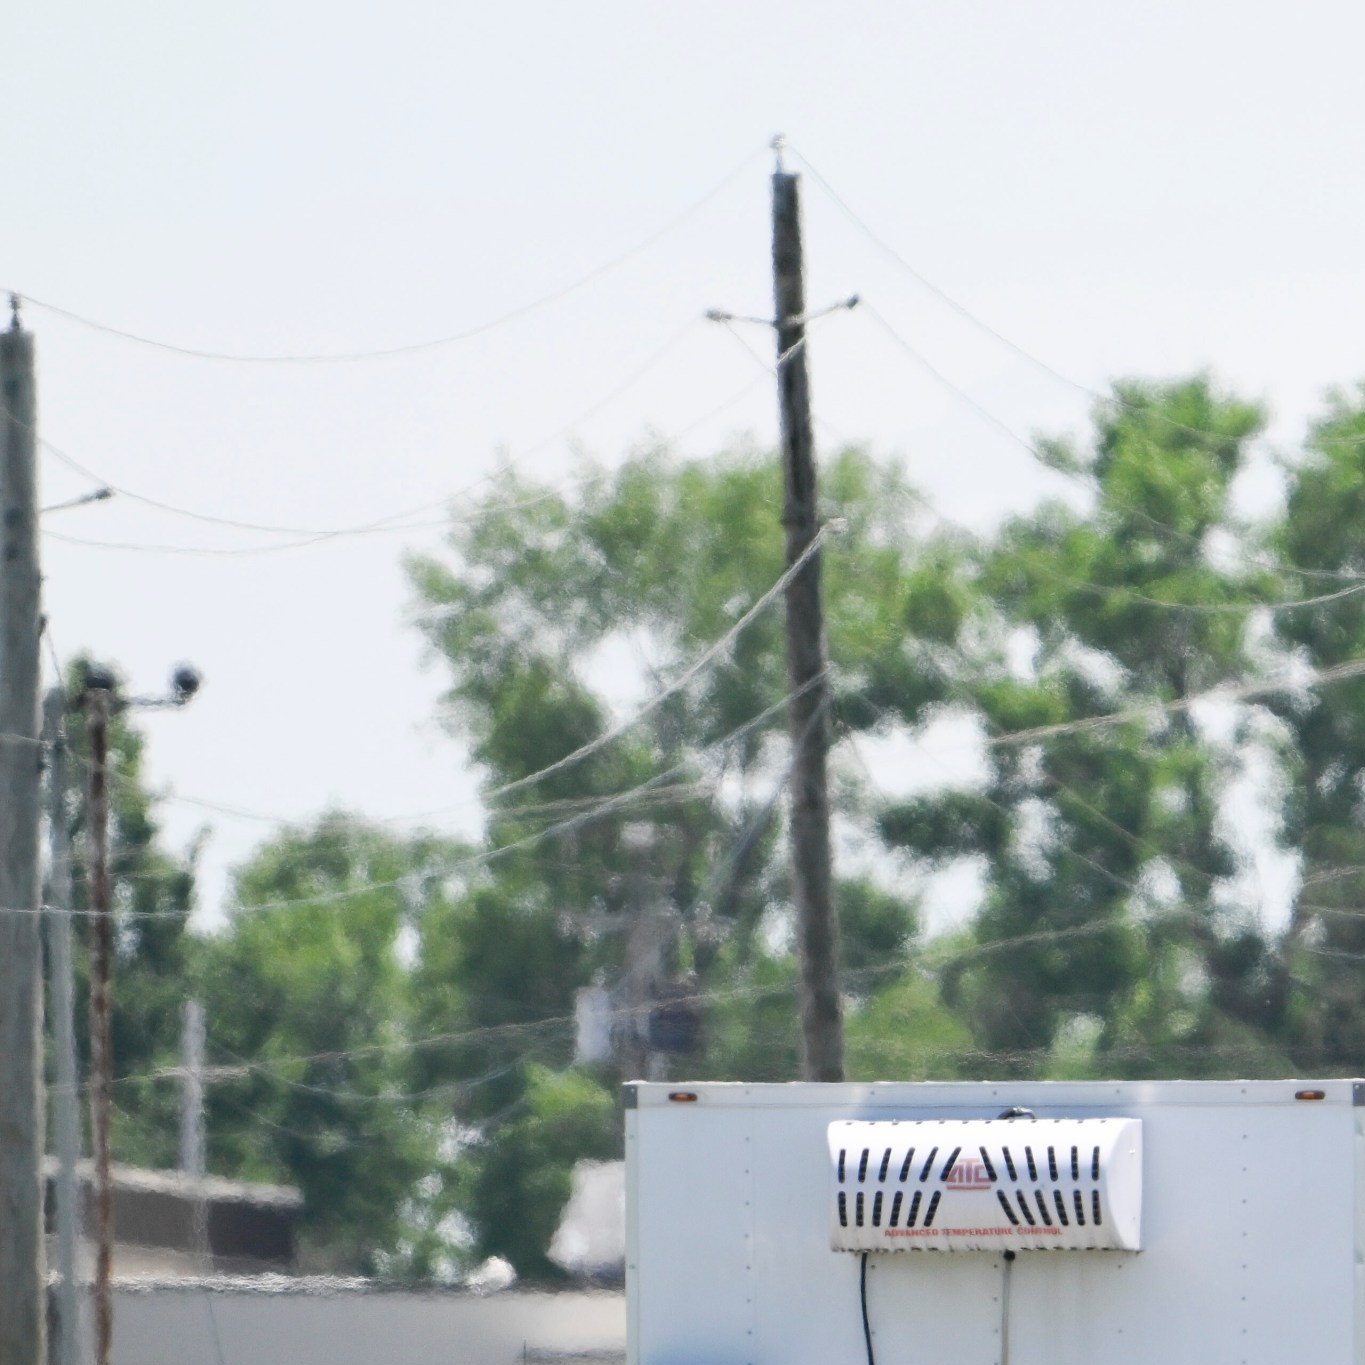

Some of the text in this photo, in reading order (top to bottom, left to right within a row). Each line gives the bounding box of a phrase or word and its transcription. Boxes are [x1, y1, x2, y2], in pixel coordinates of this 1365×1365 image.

[884, 1226, 1063, 1238] ADVANCED TEMPERATURE CONTROL
